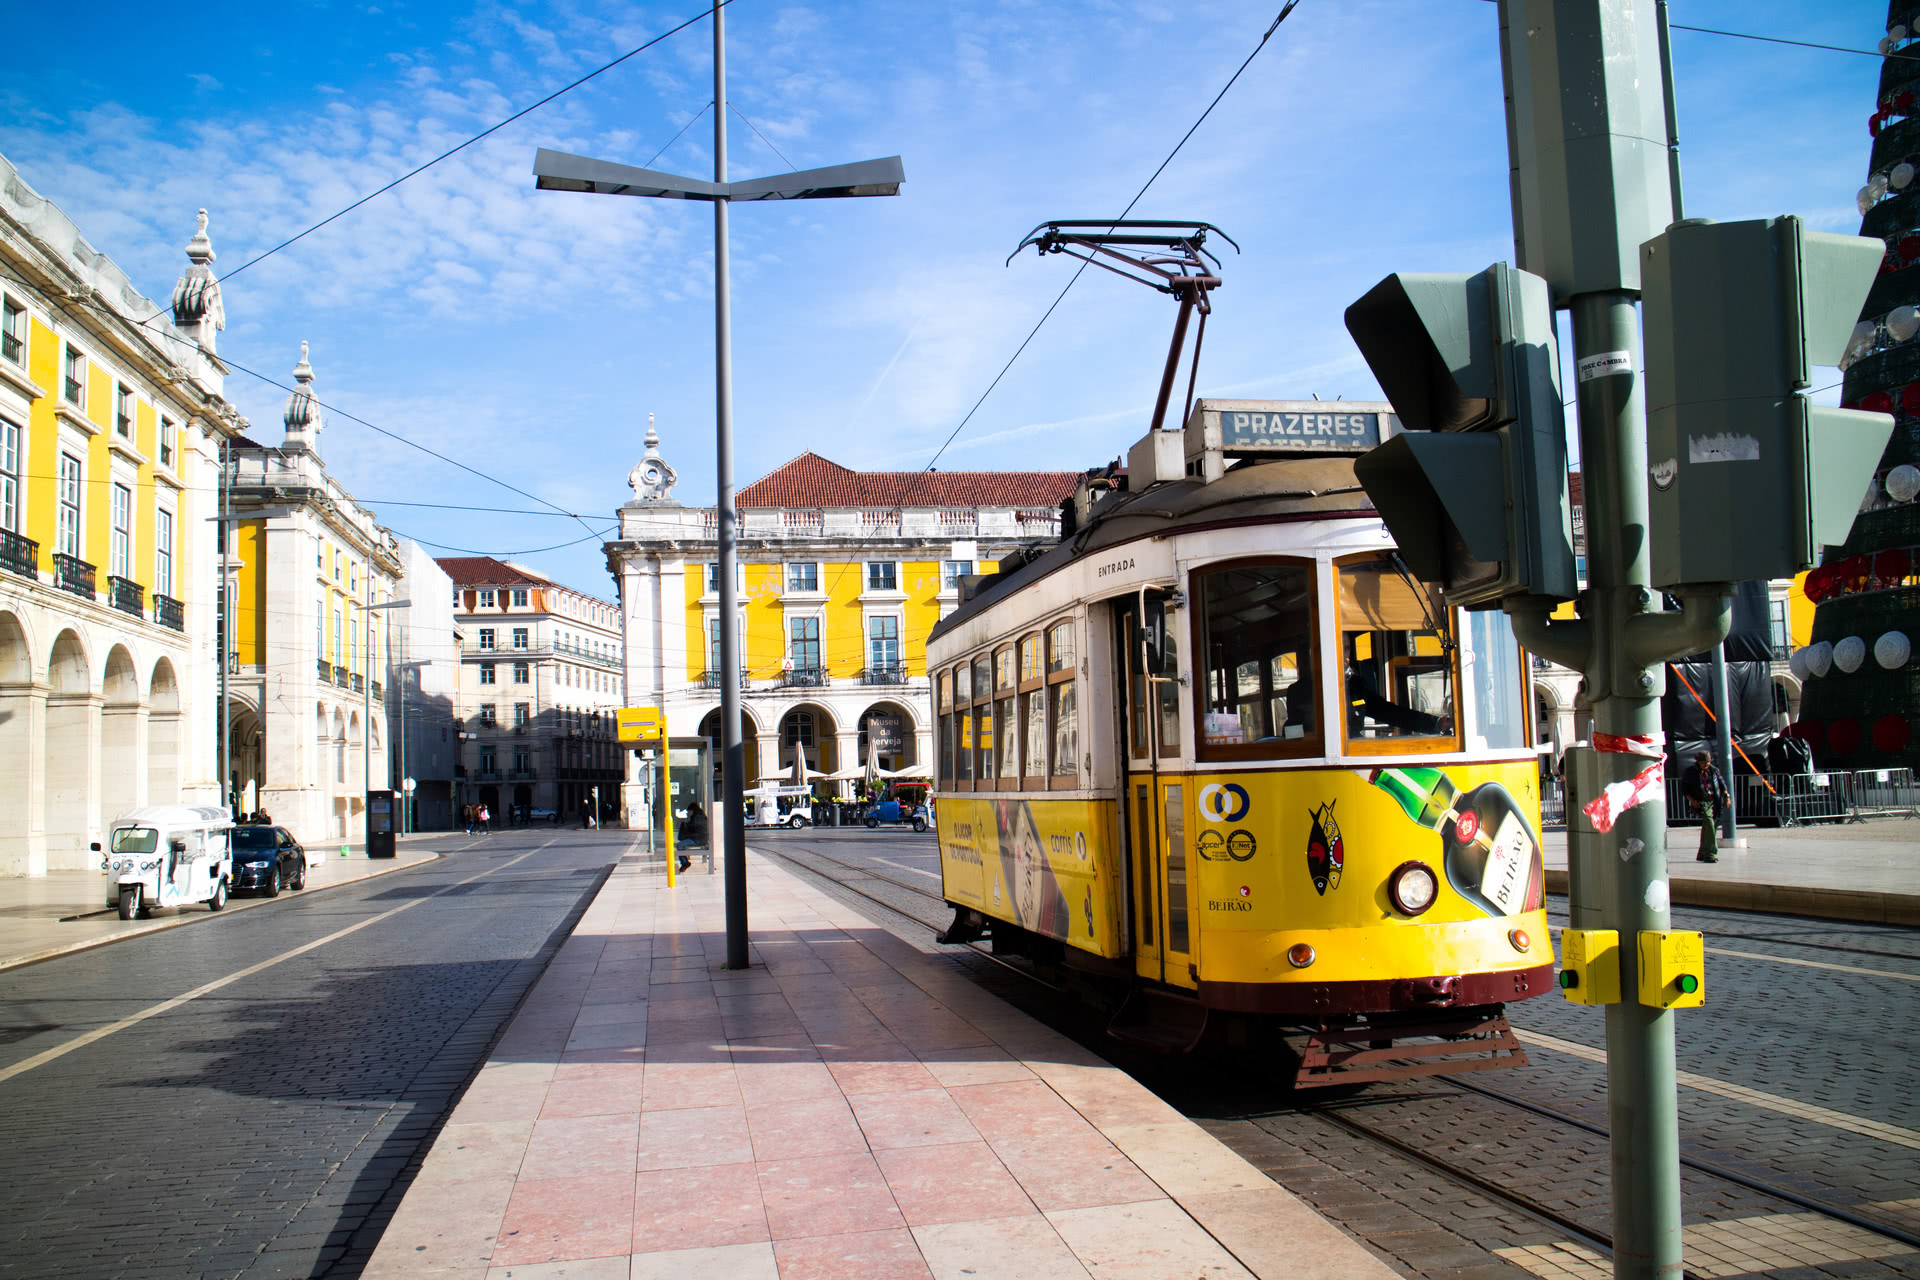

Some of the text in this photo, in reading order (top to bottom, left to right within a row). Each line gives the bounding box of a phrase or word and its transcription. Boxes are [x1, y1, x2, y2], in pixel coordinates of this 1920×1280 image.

[1233, 413, 1366, 435] PRAZERES
[1098, 557, 1136, 578] ENTRADA
[879, 728, 891, 736] da
[873, 737, 901, 746] erveja
[1208, 900, 1252, 912] BEIRÃO
